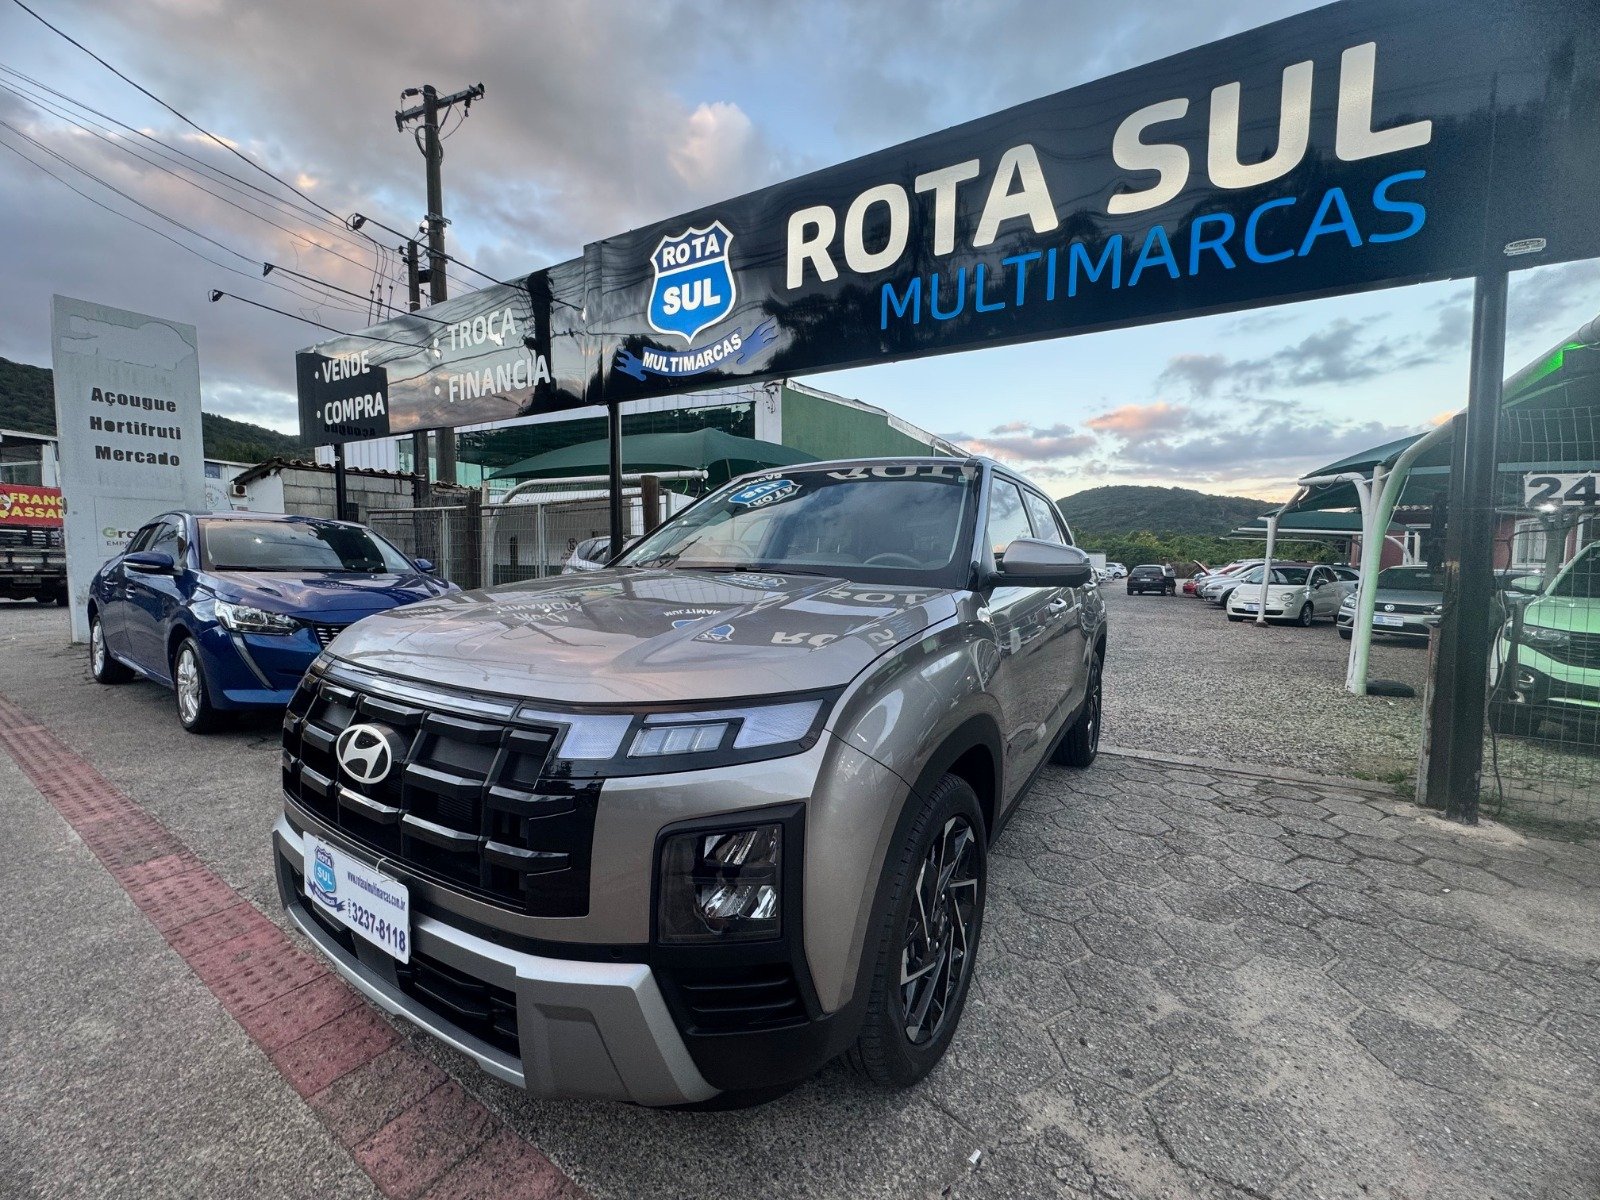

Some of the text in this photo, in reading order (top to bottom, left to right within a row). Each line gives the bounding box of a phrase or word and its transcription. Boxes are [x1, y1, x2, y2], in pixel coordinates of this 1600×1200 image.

[786, 41, 1432, 289] ROTA SUL
[662, 233, 721, 268] ROTA
[879, 169, 1427, 330] MULTIMARCAS
[662, 277, 721, 316] SUL
[446, 307, 517, 351] TROÇA
[321, 350, 371, 384] VENDE
[642, 333, 742, 373] MULTIMARCAS
[449, 354, 551, 403] FINANCIA
[91, 387, 177, 413] Açougue
[324, 391, 386, 425] COMPRA
[89, 415, 182, 441] Hortifruti
[94, 445, 180, 467] Mercado
[1528, 476, 1600, 506] 24
[317, 866, 333, 886] SUL
[352, 901, 406, 952] 3237-8118
